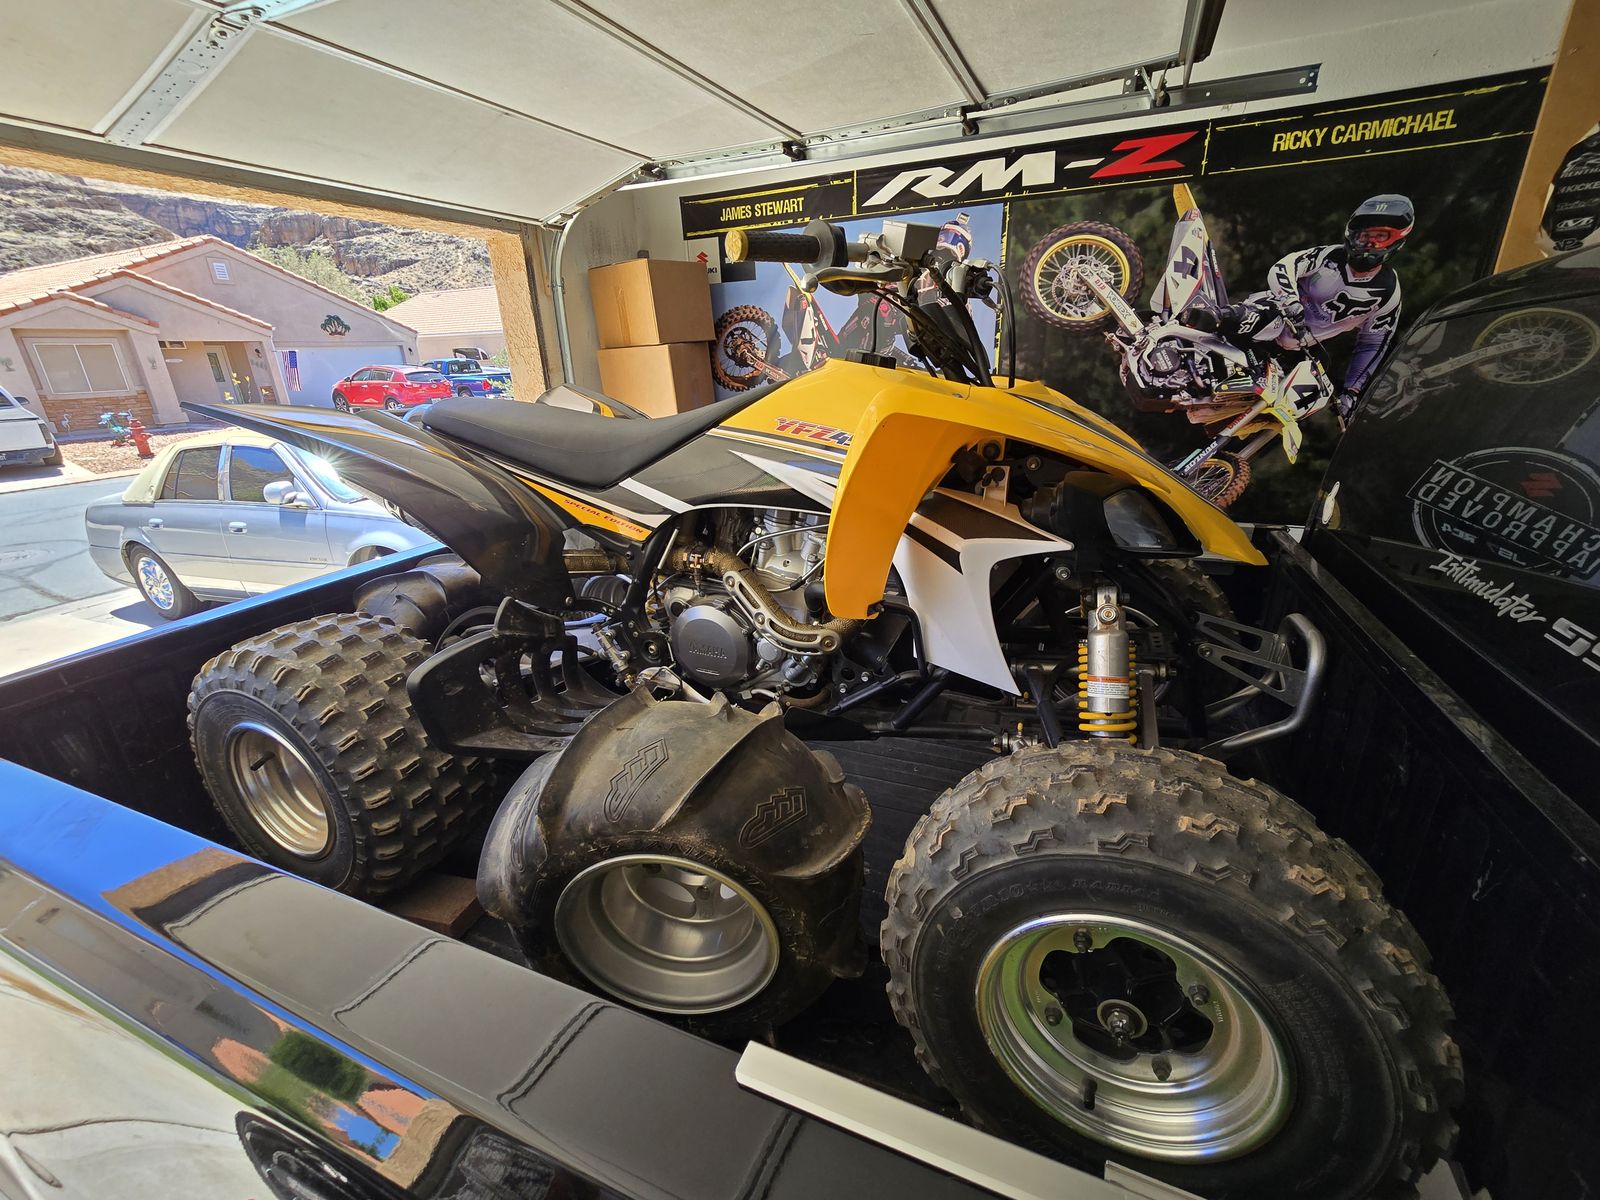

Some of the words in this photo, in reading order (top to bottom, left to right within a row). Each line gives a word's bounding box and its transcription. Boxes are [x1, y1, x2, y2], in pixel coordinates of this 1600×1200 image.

[1272, 127, 1329, 152] RICKY
[1331, 109, 1457, 144] CARMICHAEL
[862, 131, 1199, 207] RM-Z
[720, 205, 752, 222] JAMES
[754, 197, 805, 217] STEWART
[1173, 245, 1200, 280] 4
[1291, 384, 1321, 410] 4
[1184, 440, 1218, 472] DUNLOP
[564, 499, 600, 516] SPECIAL
[603, 515, 644, 534] EDITION
[1430, 548, 1546, 623] Intimidator
